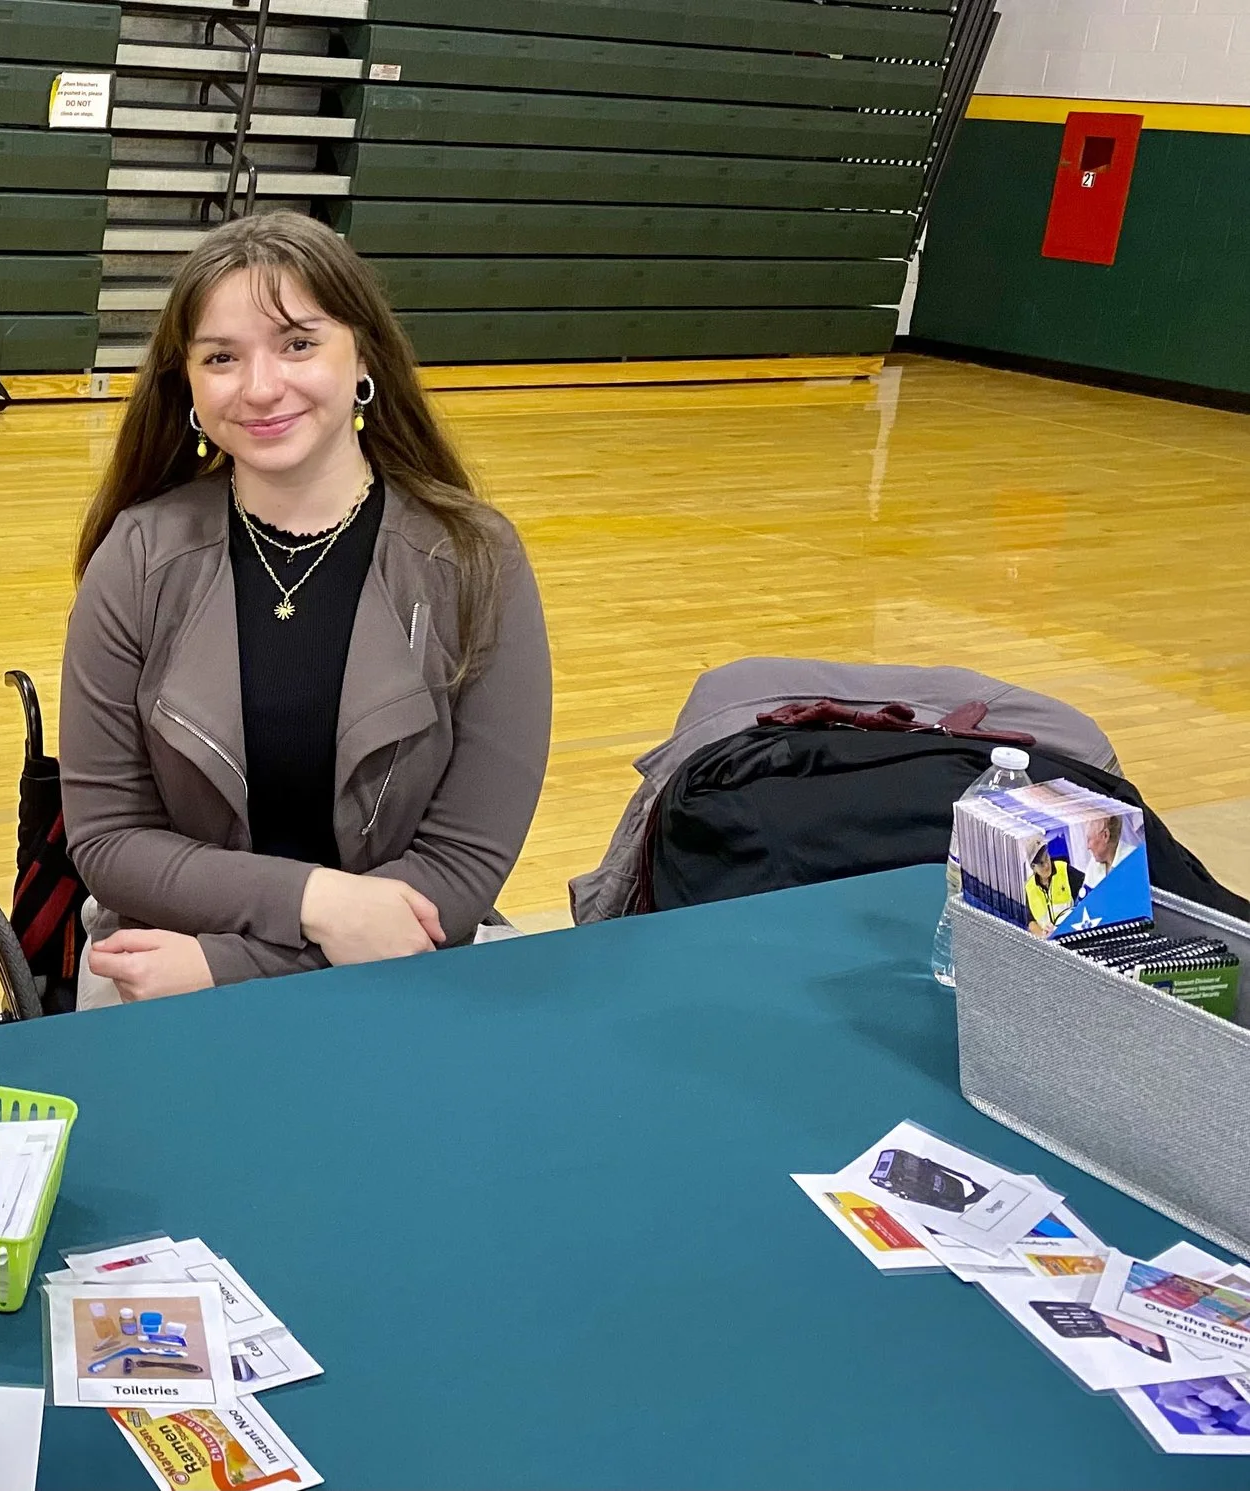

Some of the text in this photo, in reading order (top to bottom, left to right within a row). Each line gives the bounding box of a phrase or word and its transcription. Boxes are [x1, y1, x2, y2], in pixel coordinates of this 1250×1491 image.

[1083, 172, 1096, 187] 21
[1145, 1302, 1180, 1319] Over
[1182, 1314, 1207, 1329] the
[243, 1340, 263, 1357] Cell
[1166, 1319, 1245, 1350] Pain Relief
[113, 1385, 179, 1396] Toiletries
[138, 1427, 178, 1477] Maruchan
[158, 1424, 202, 1474] Ramen
[187, 1420, 223, 1462] Chicken
[244, 1430, 280, 1465] Instant
